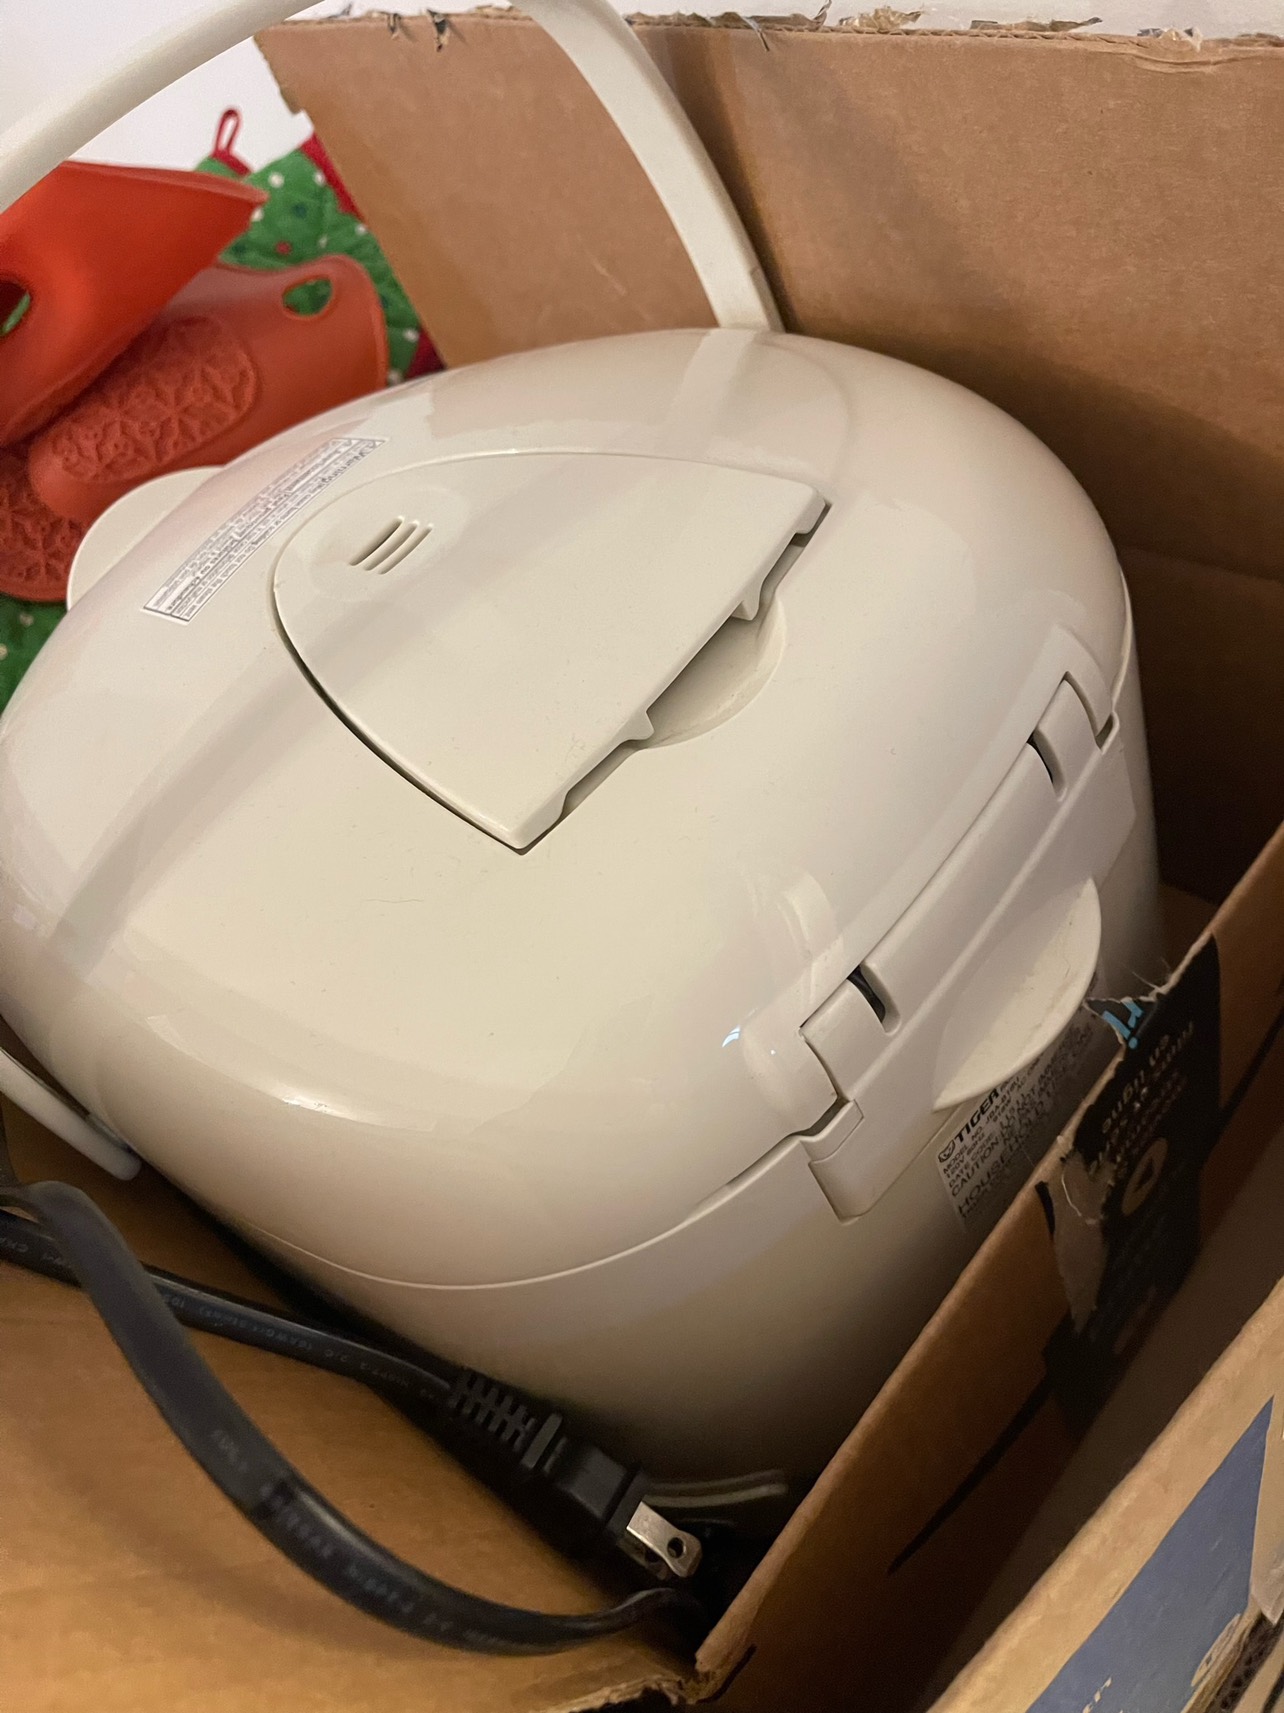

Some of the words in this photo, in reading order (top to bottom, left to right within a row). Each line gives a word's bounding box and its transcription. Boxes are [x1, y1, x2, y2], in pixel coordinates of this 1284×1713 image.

[955, 1088, 1000, 1143] TIGER
[941, 1144, 968, 1174] MODEL
[945, 1155, 966, 1178] 120V
[947, 1161, 971, 1188] DATE
[969, 1132, 994, 1161] CODE
[955, 1099, 1047, 1214] HOUSEHOLD
